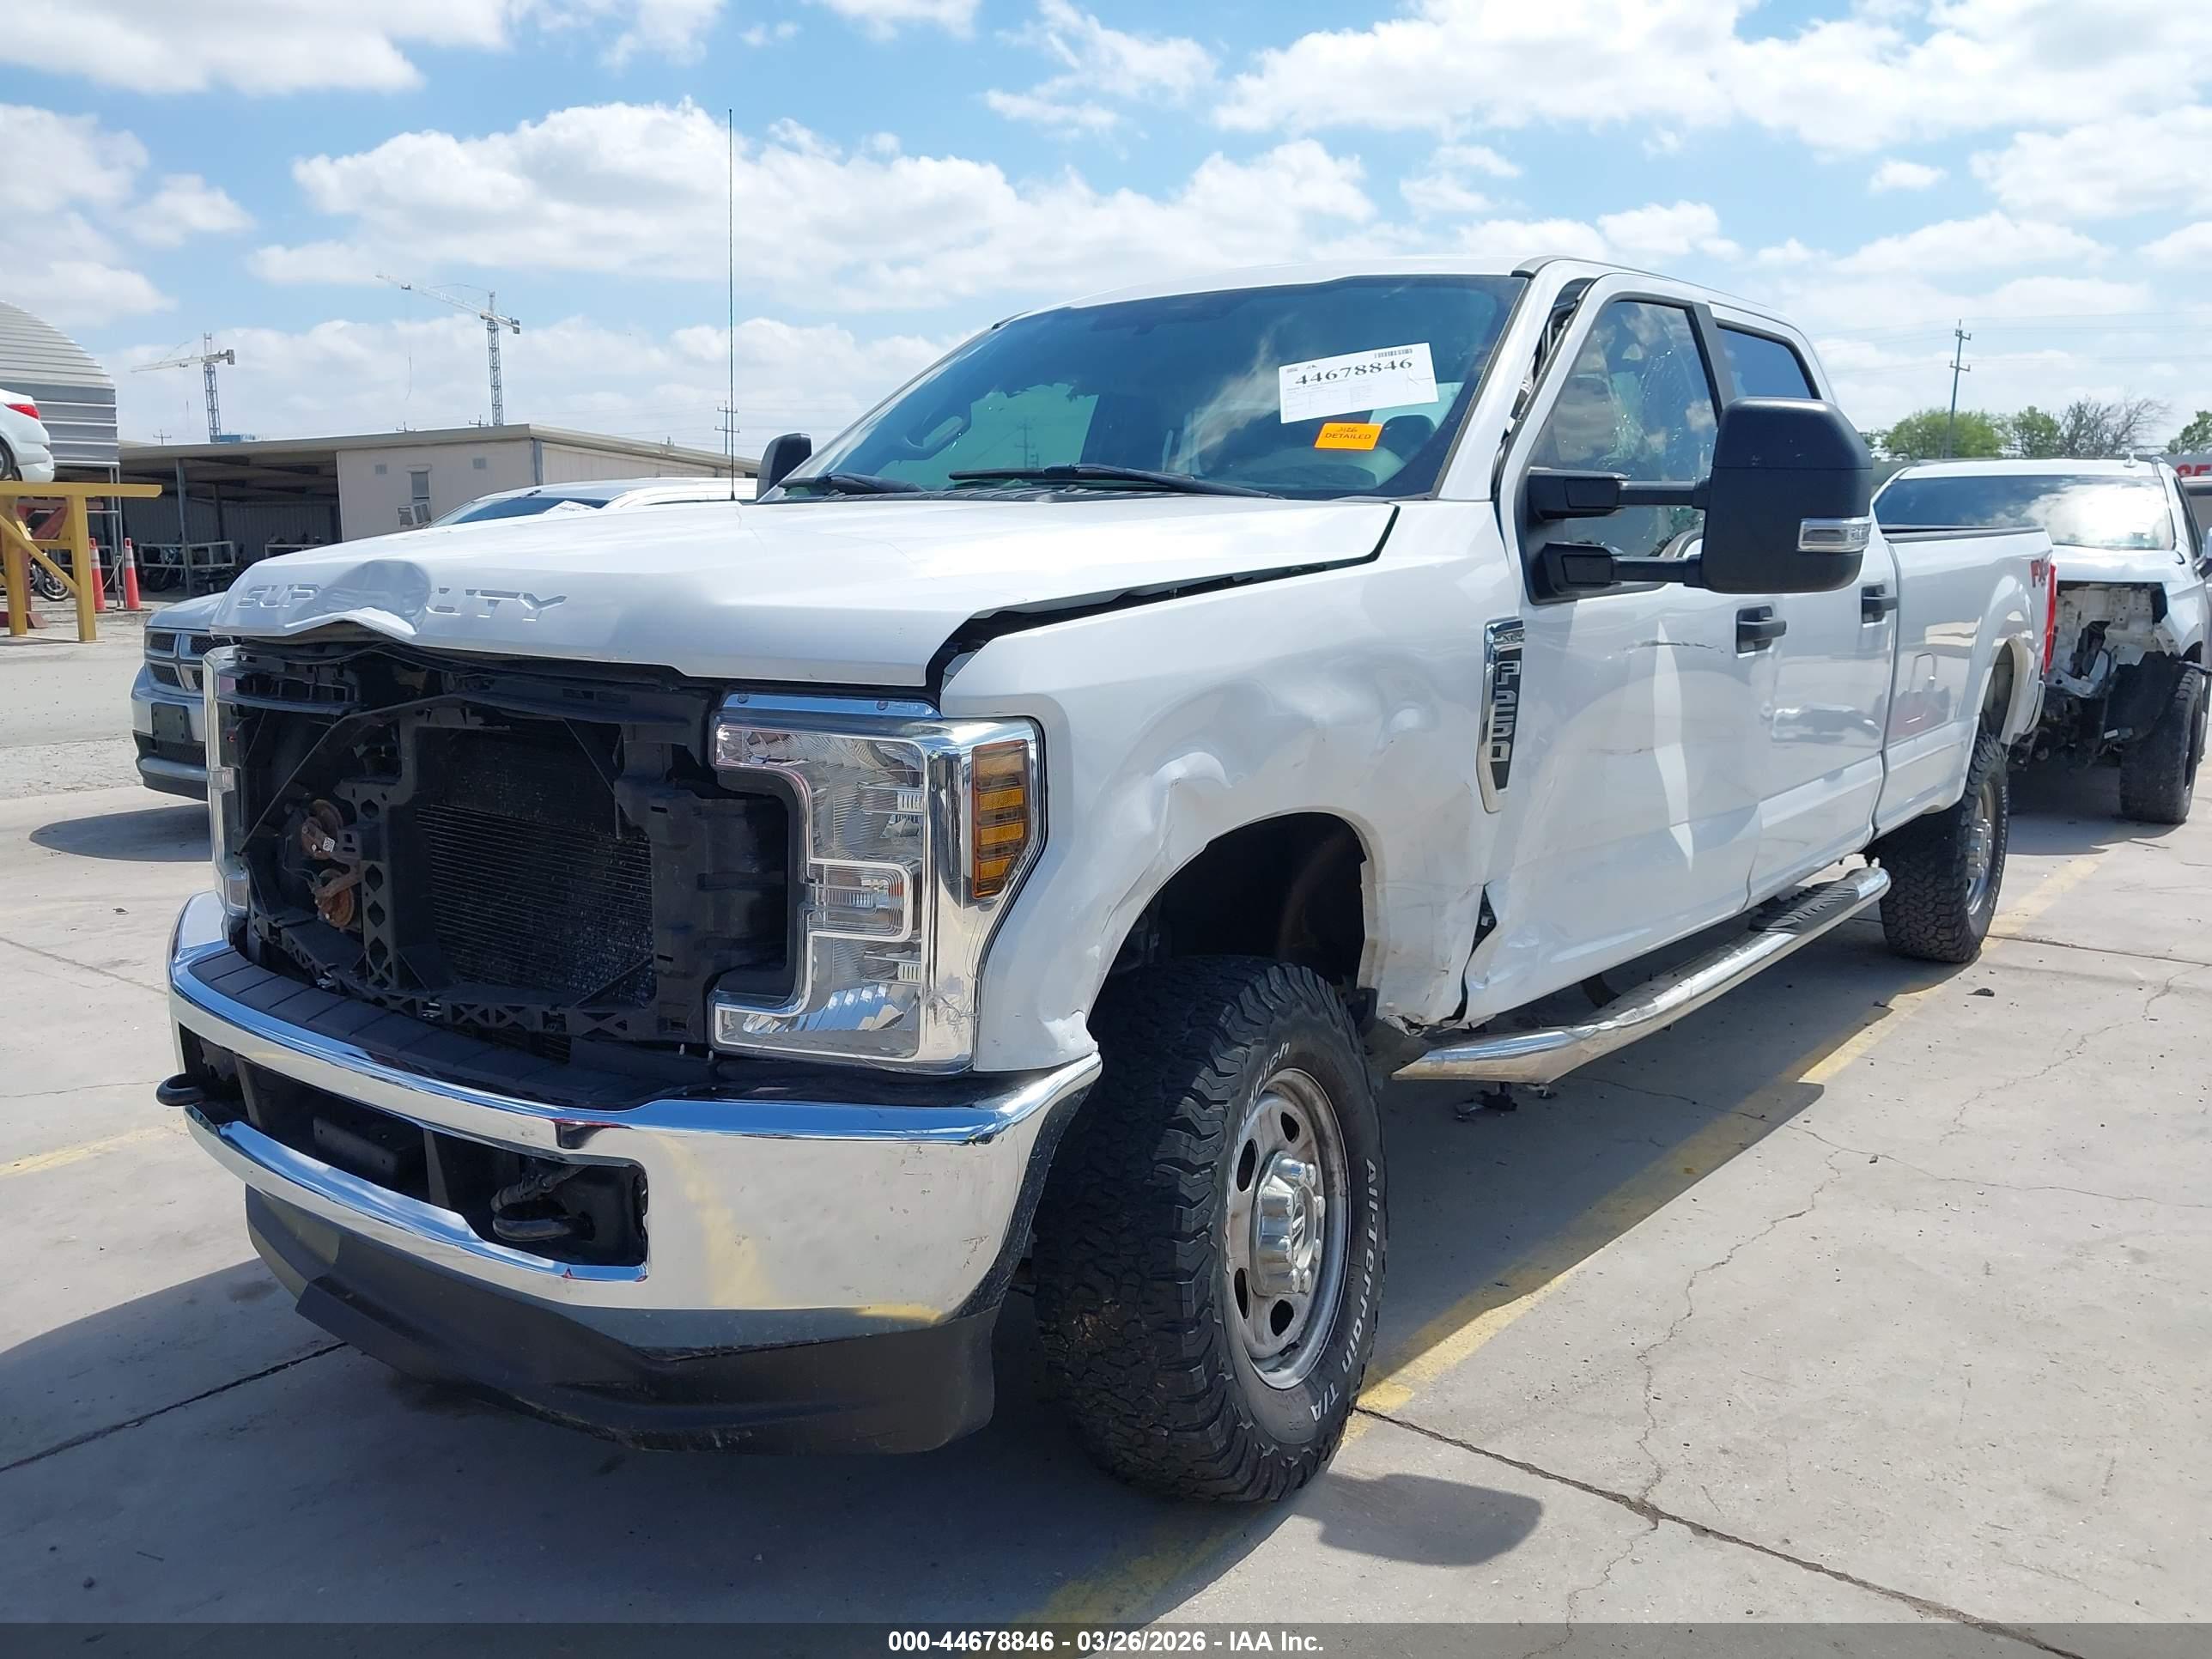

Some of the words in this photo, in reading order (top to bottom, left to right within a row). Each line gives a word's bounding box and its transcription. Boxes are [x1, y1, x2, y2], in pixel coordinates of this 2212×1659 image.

[1295, 357, 1413, 385] 44678846
[1340, 1159, 1378, 1373] All-Terrain
[1310, 1382, 1340, 1422] T/A
